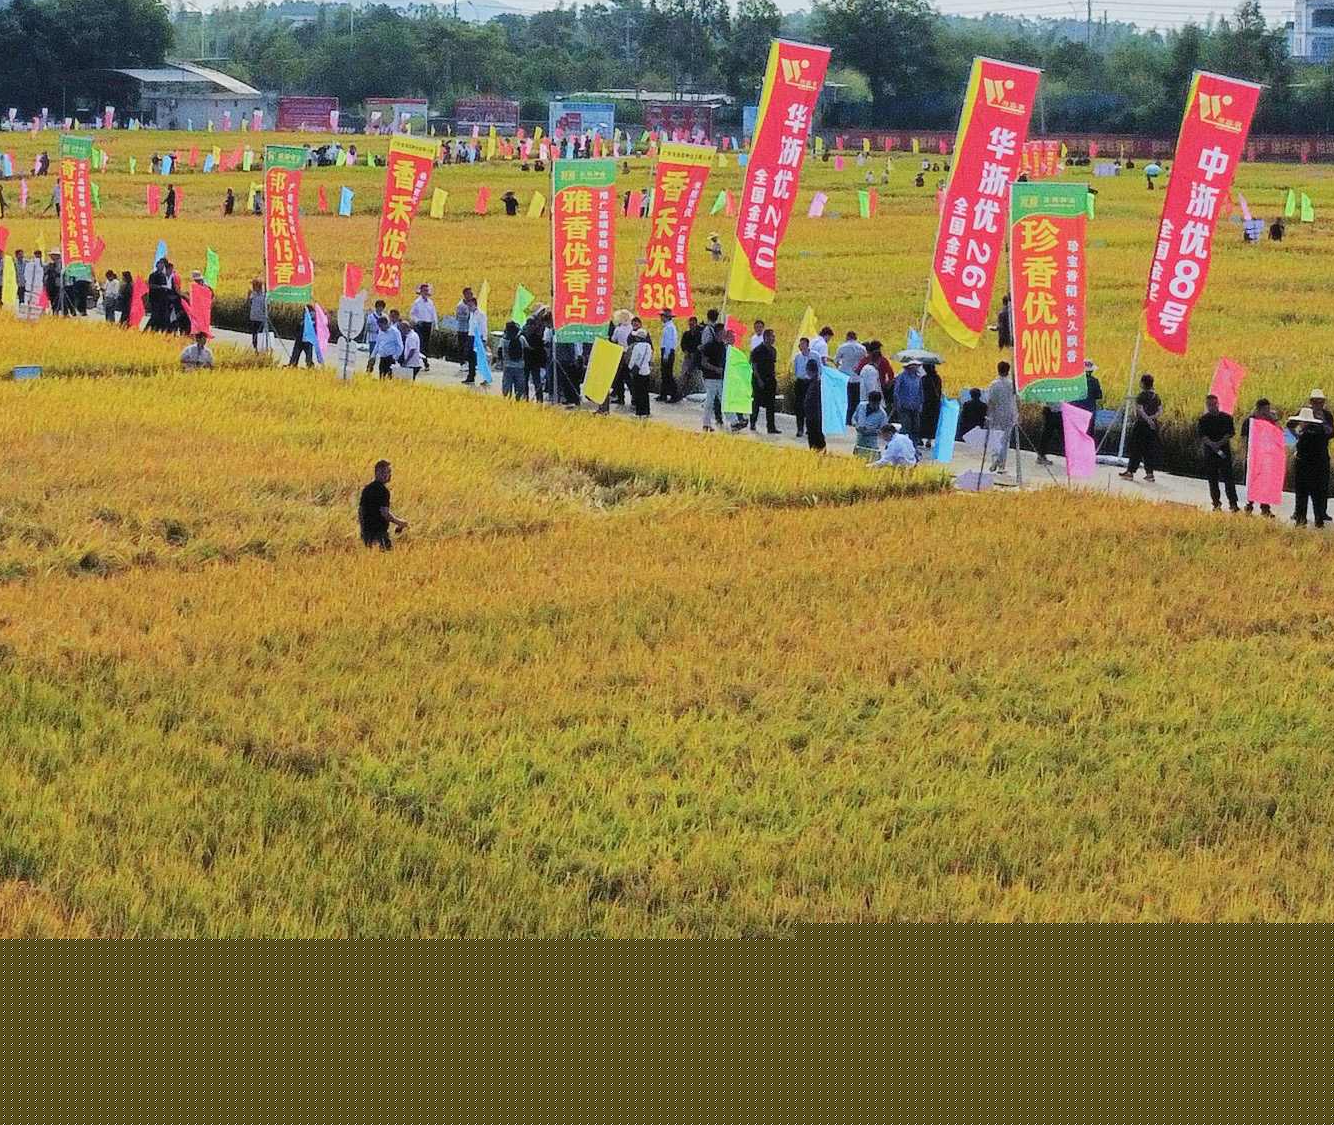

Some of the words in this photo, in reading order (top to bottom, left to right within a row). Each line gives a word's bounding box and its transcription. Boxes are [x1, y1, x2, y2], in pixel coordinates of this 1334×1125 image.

[561, 190, 593, 319] 雅香优香占
[743, 168, 768, 240] 全国金奖
[941, 196, 969, 276] 全国金奖
[955, 126, 1018, 310] 华浙优261
[1158, 146, 1230, 335] 中浙优8号
[1020, 218, 1062, 375] 珍香优2009
